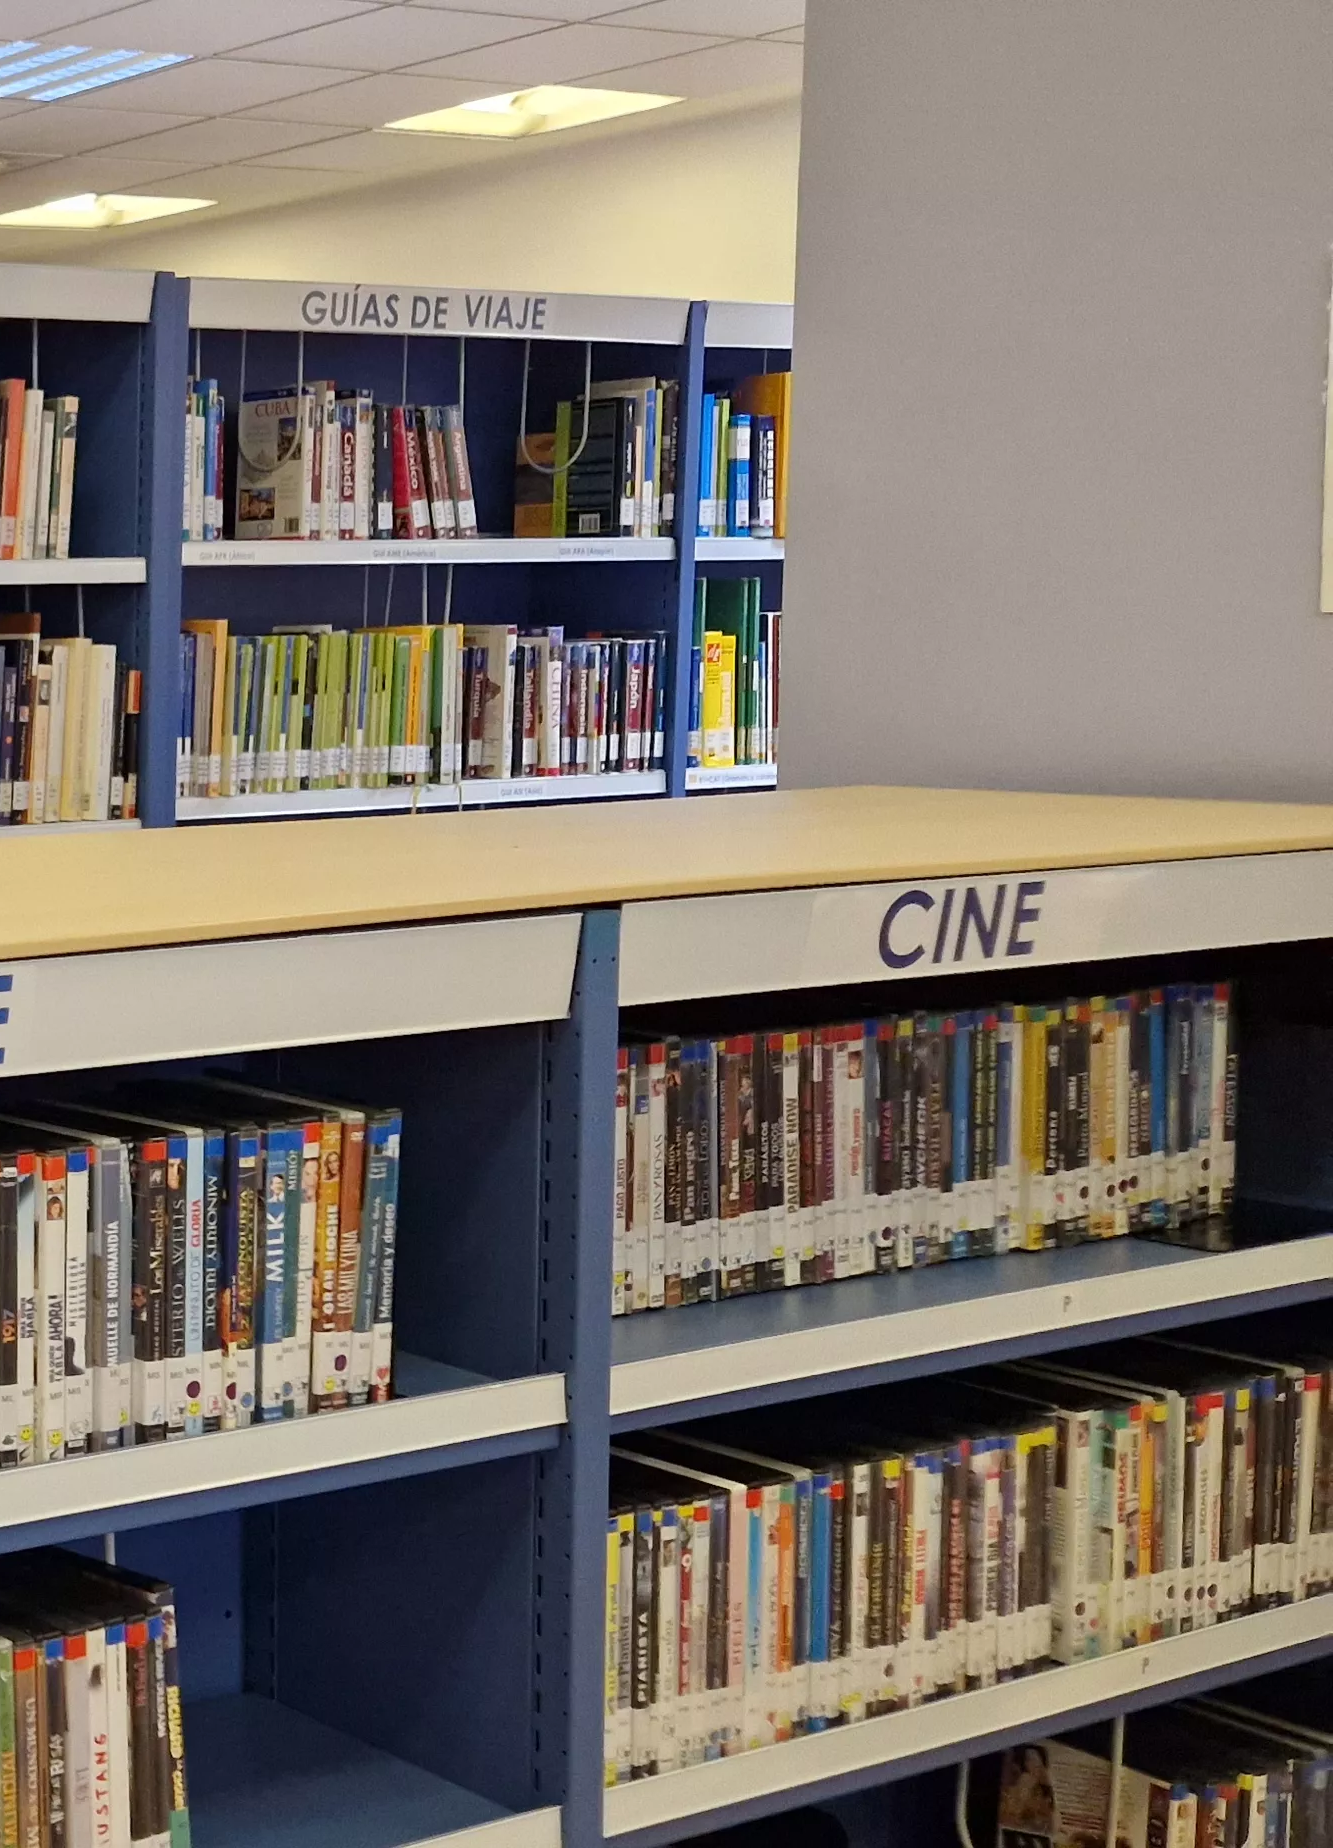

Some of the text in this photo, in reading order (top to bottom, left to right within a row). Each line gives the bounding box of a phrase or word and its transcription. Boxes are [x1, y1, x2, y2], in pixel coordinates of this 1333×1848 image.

[301, 285, 547, 330] GUÍAS DE VIAJE
[255, 402, 292, 418] CUBA
[341, 432, 355, 498] Canadá
[405, 432, 419, 490] México
[453, 431, 467, 490] Argentina
[629, 665, 641, 710] Japón
[879, 881, 1045, 968] CINE
[787, 1098, 798, 1213] PARADISE NOW
[191, 1199, 202, 1248] GLORIA
[266, 1211, 285, 1282] MILK
[382, 1203, 395, 1243] deseo
[104, 1221, 119, 1298] NORMANDÍA
[107, 1301, 119, 1318] DE
[378, 1259, 393, 1318] Memoria
[1063, 1295, 1071, 1312] P
[2, 1309, 16, 1344] 1917
[636, 1613, 649, 1703] PIANISTA
[1142, 1657, 1150, 1675] P
